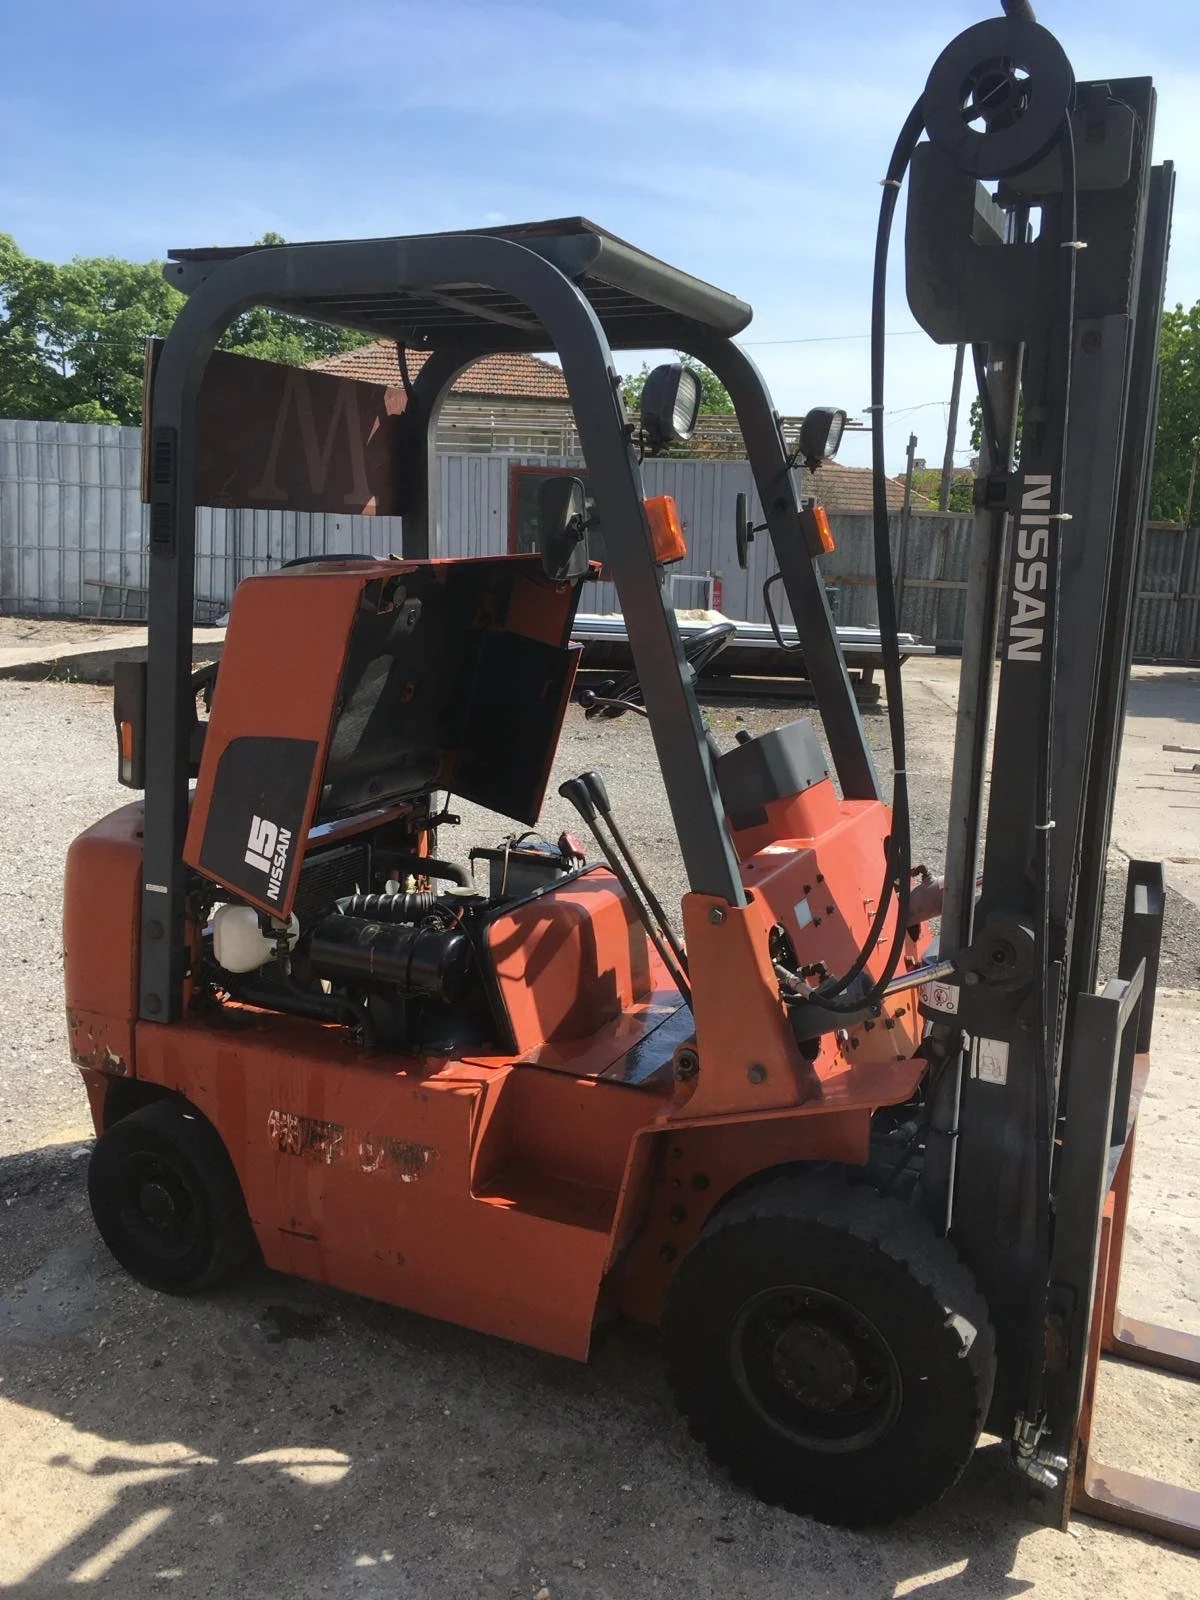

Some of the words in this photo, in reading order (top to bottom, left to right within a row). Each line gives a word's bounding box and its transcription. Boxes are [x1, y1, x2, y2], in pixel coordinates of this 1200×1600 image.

[1007, 474, 1052, 662] NISSAN
[244, 814, 278, 874] 15
[266, 827, 292, 901] NISSAN
